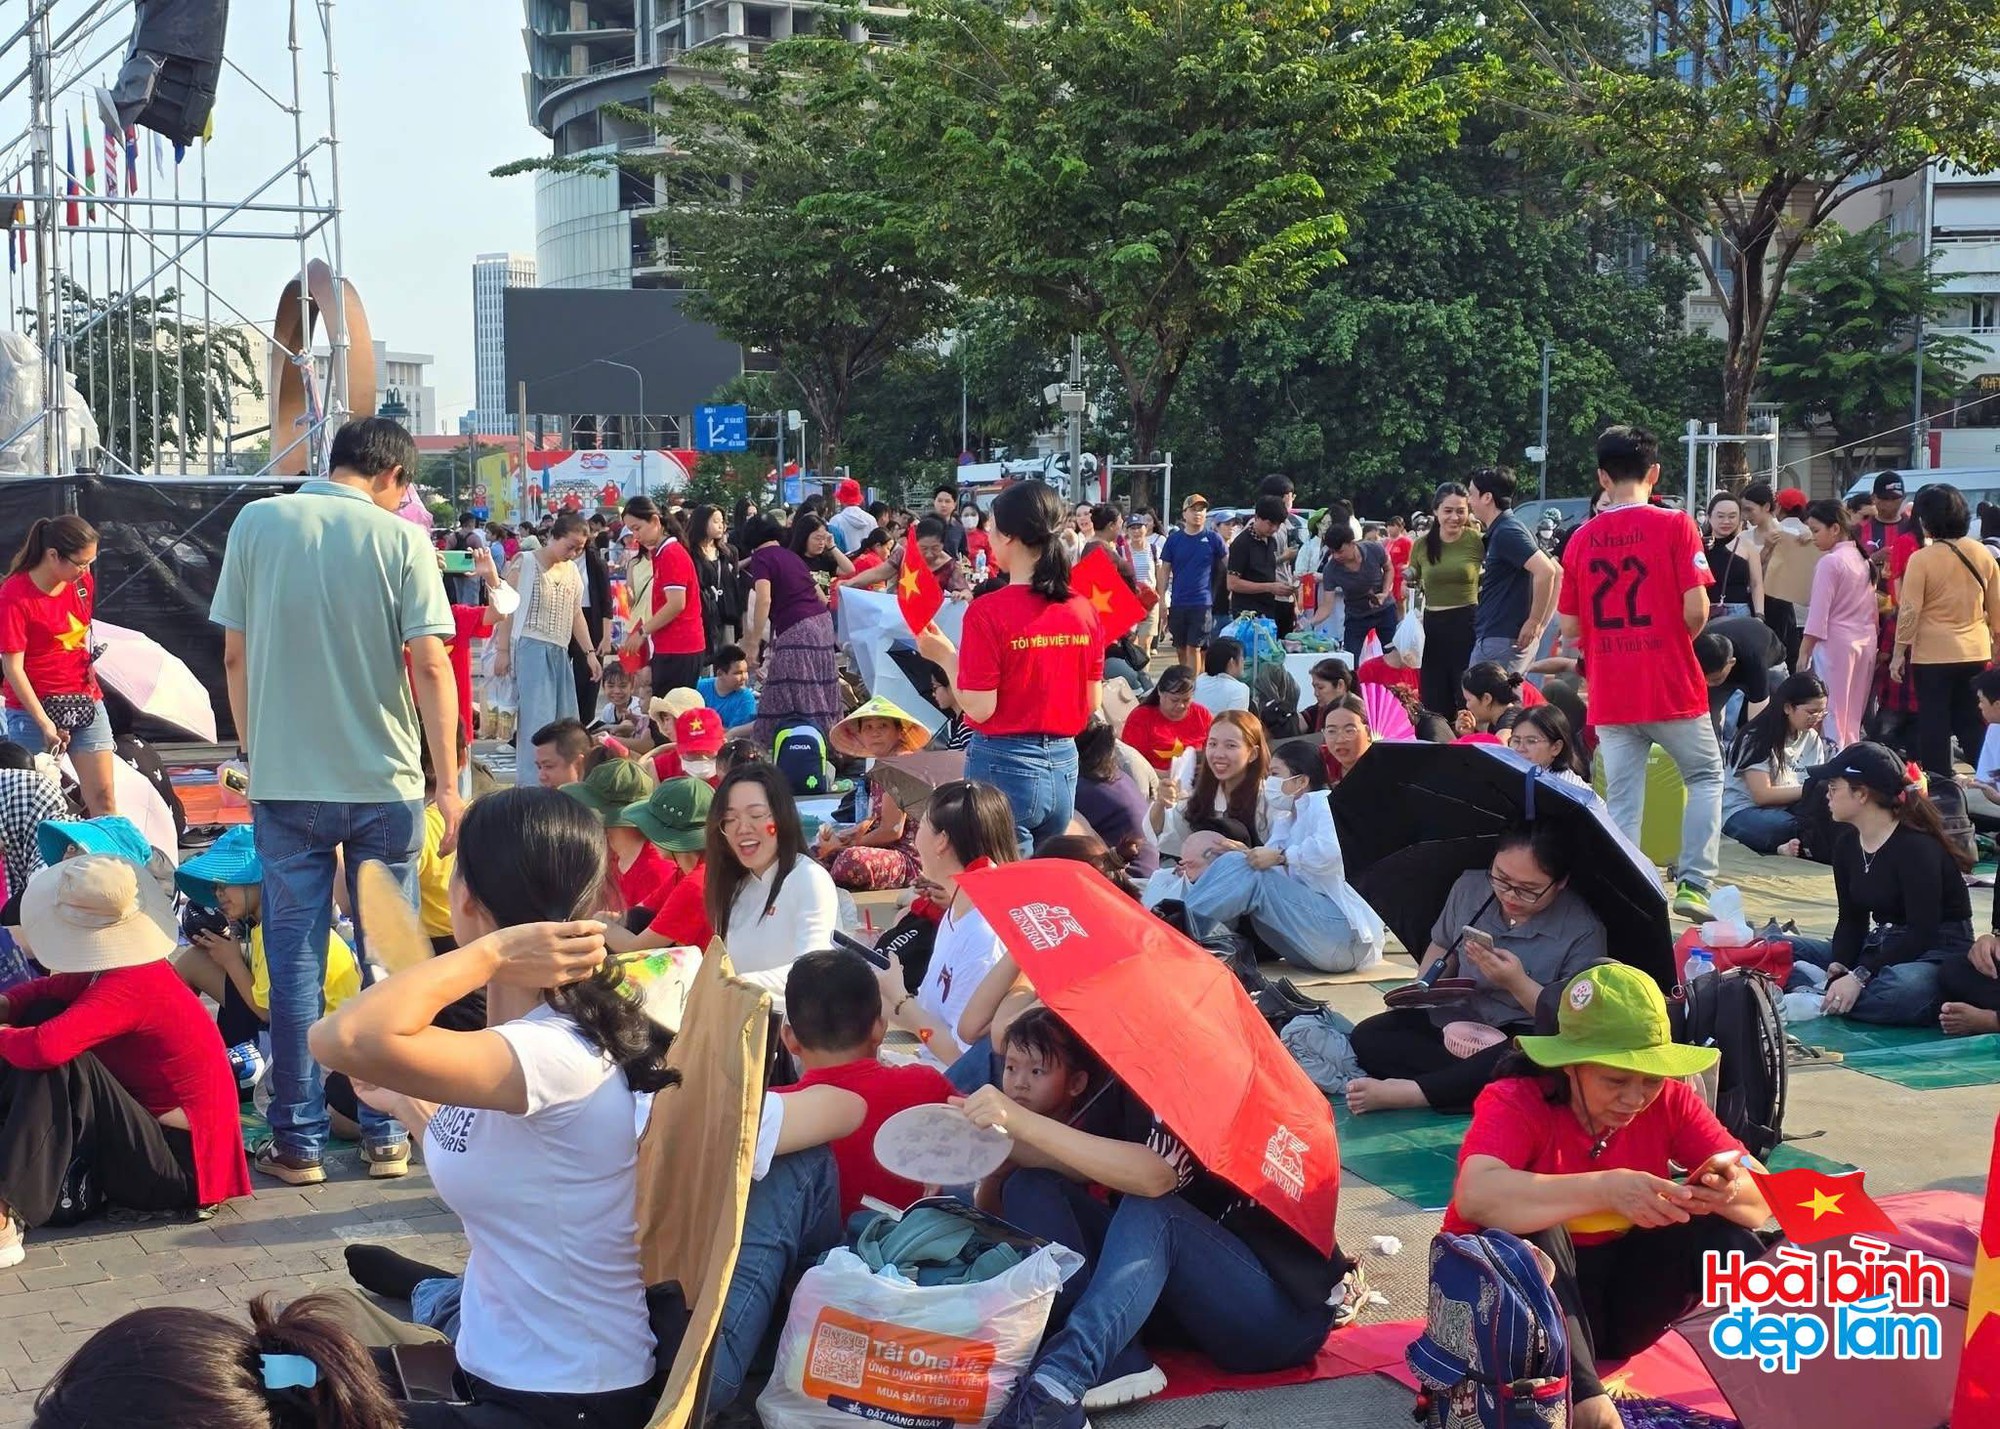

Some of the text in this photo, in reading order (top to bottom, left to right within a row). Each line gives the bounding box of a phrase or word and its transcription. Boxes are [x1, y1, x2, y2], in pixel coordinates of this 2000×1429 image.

[1589, 555, 1653, 630] 22
[1010, 636, 1029, 650] TÔI
[1008, 908, 1051, 950] GENERALI
[873, 1340, 905, 1362] Tải
[876, 1386, 900, 1400] MUA
[886, 1413, 915, 1426] HÀNG
[915, 1419, 943, 1427] NGAY
